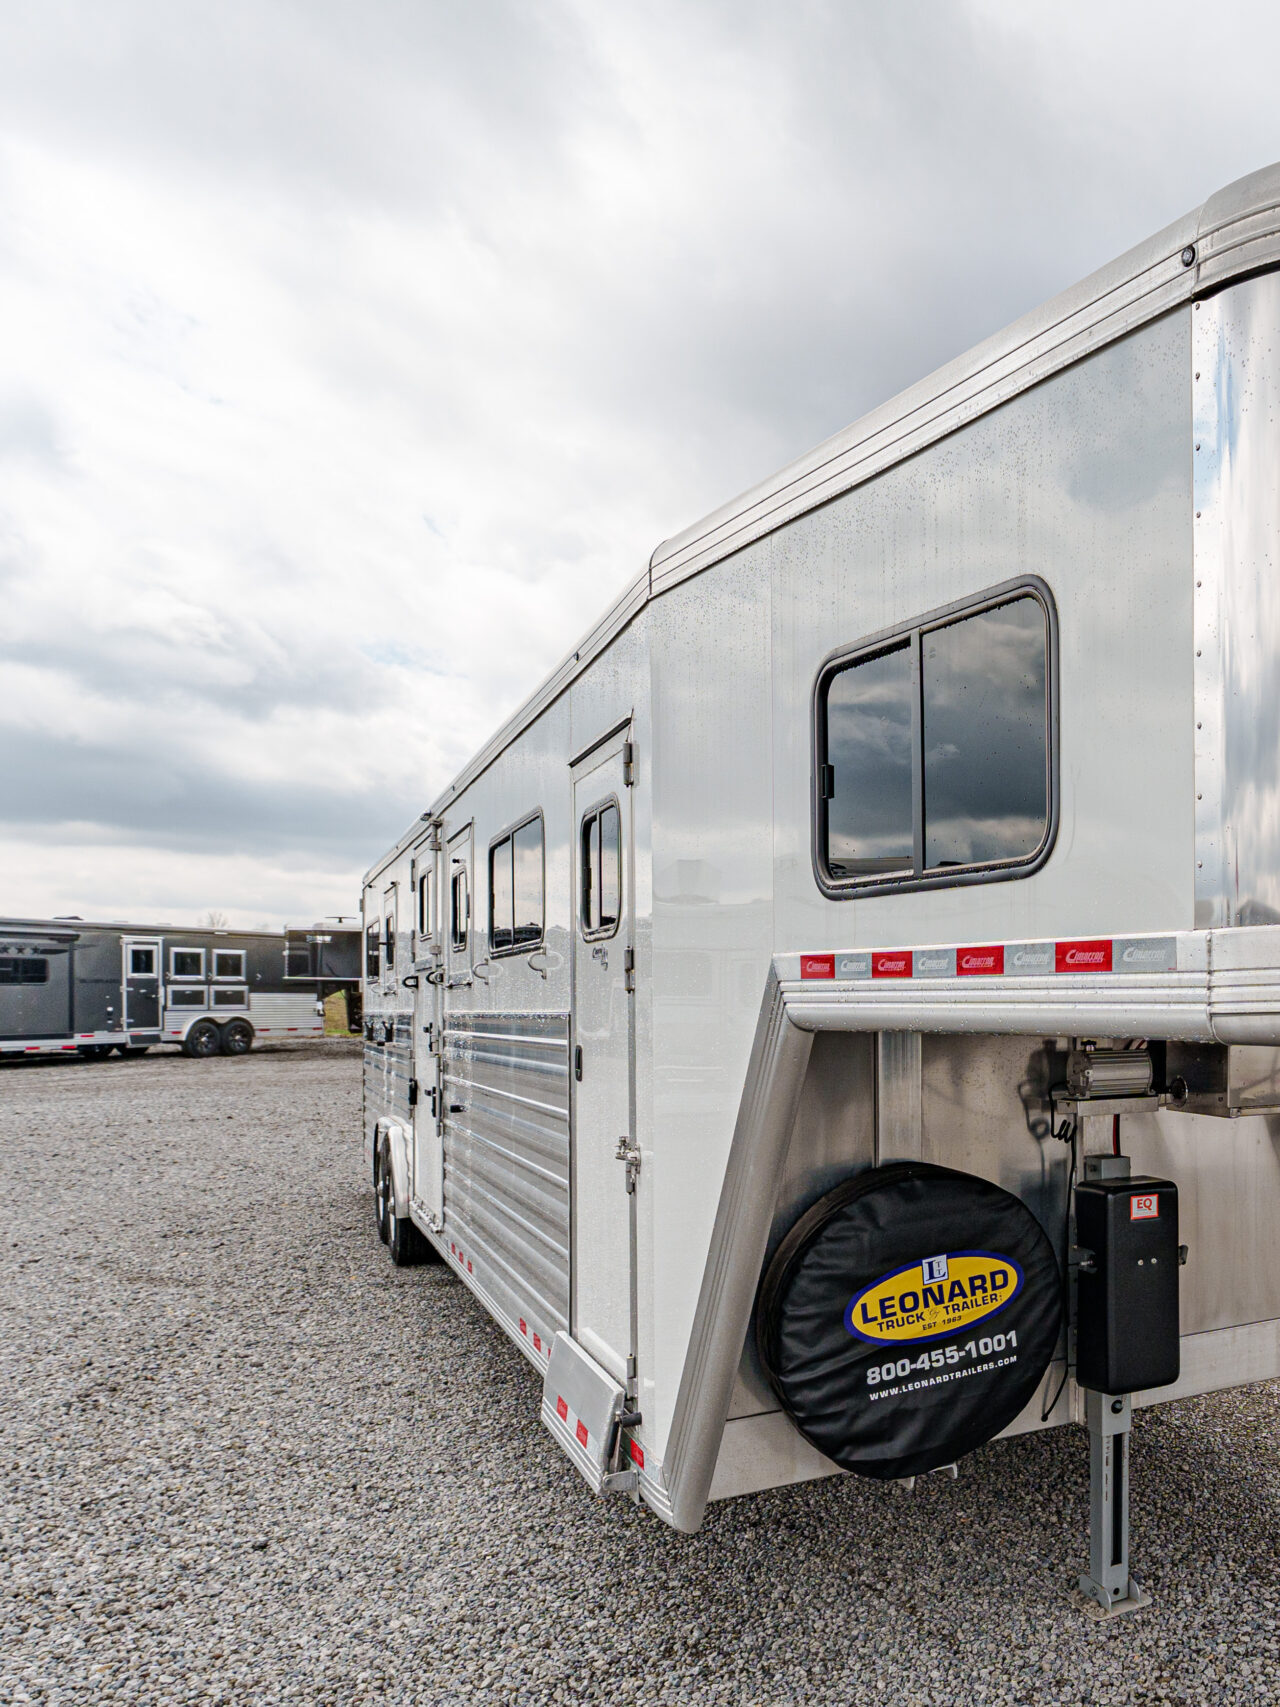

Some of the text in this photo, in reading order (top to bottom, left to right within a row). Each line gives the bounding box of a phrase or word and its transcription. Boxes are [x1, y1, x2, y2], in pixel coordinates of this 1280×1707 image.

[1137, 1198, 1153, 1211] EQ
[860, 1268, 1009, 1325] LEONARD
[877, 1311, 926, 1333] TRUCK
[922, 1322, 937, 1331] EST
[866, 1329, 1018, 1385] 800-455-1001
[869, 1355, 1018, 1401] WWW.LEONARDTRAILERS.COM
